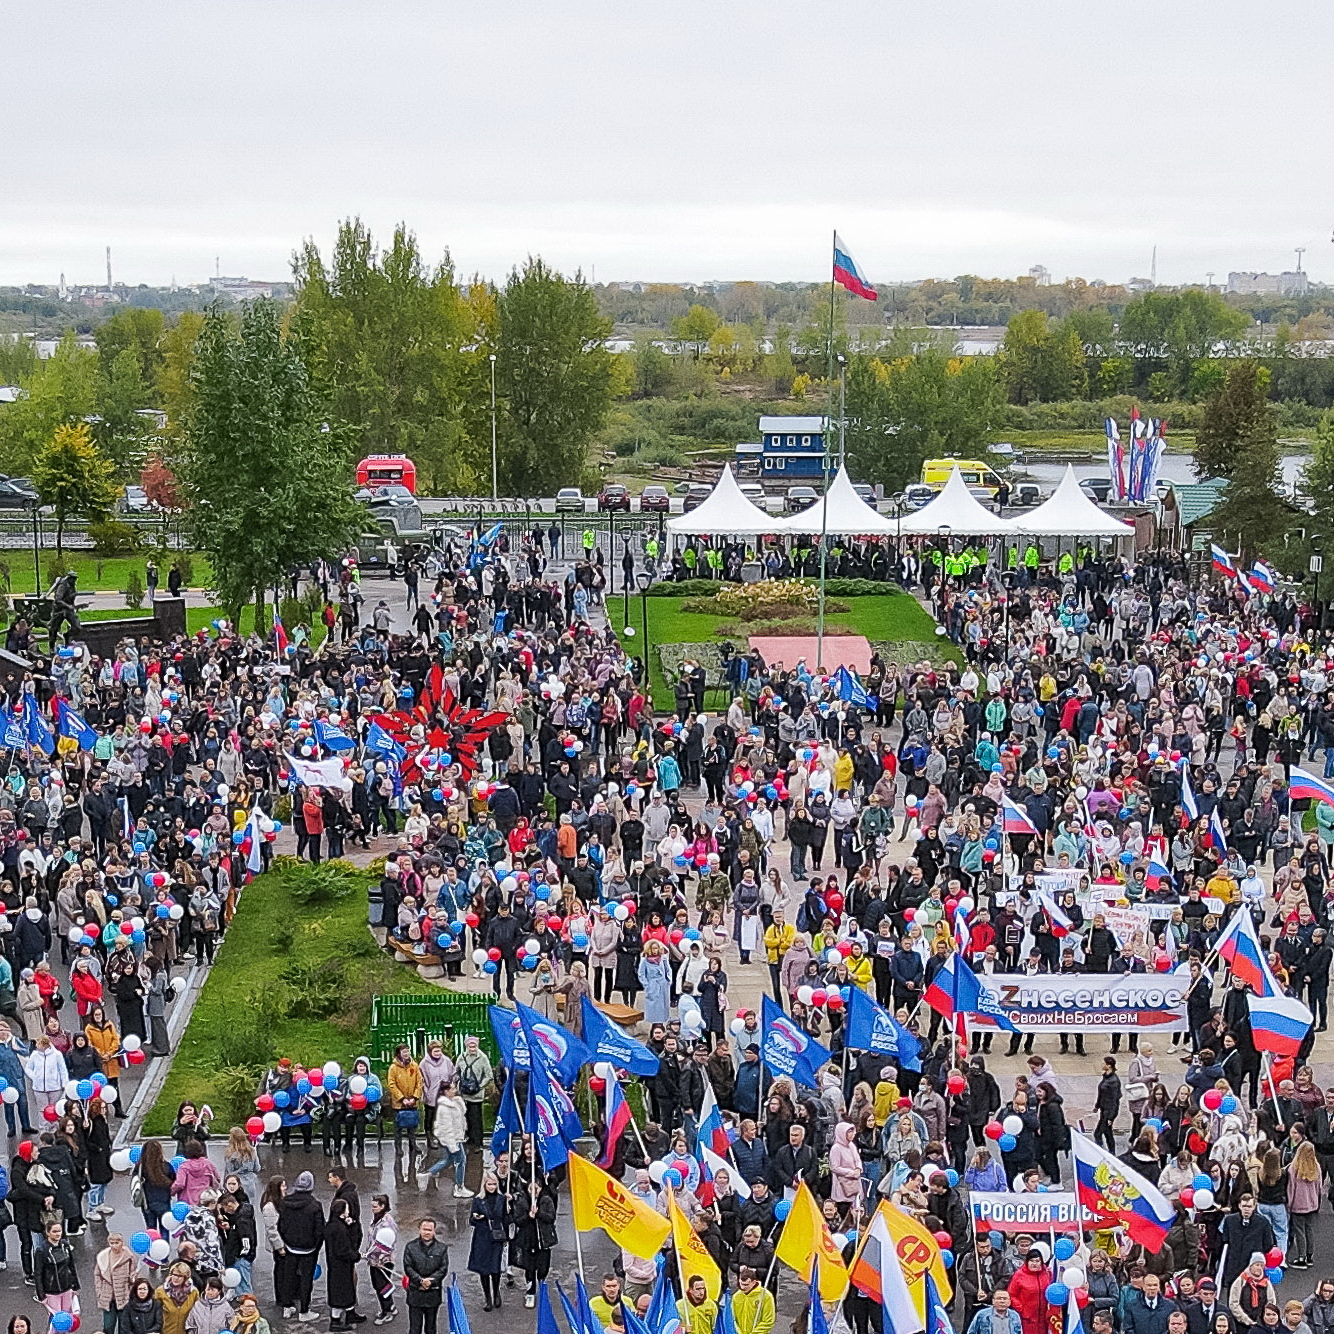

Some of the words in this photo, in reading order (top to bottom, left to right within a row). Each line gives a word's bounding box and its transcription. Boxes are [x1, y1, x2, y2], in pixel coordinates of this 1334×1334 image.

[985, 985, 1181, 1008] оZнесенское
[1009, 1010, 1138, 1027] СвоихНеБросаем
[980, 1201, 1051, 1223] РОССИЯ
